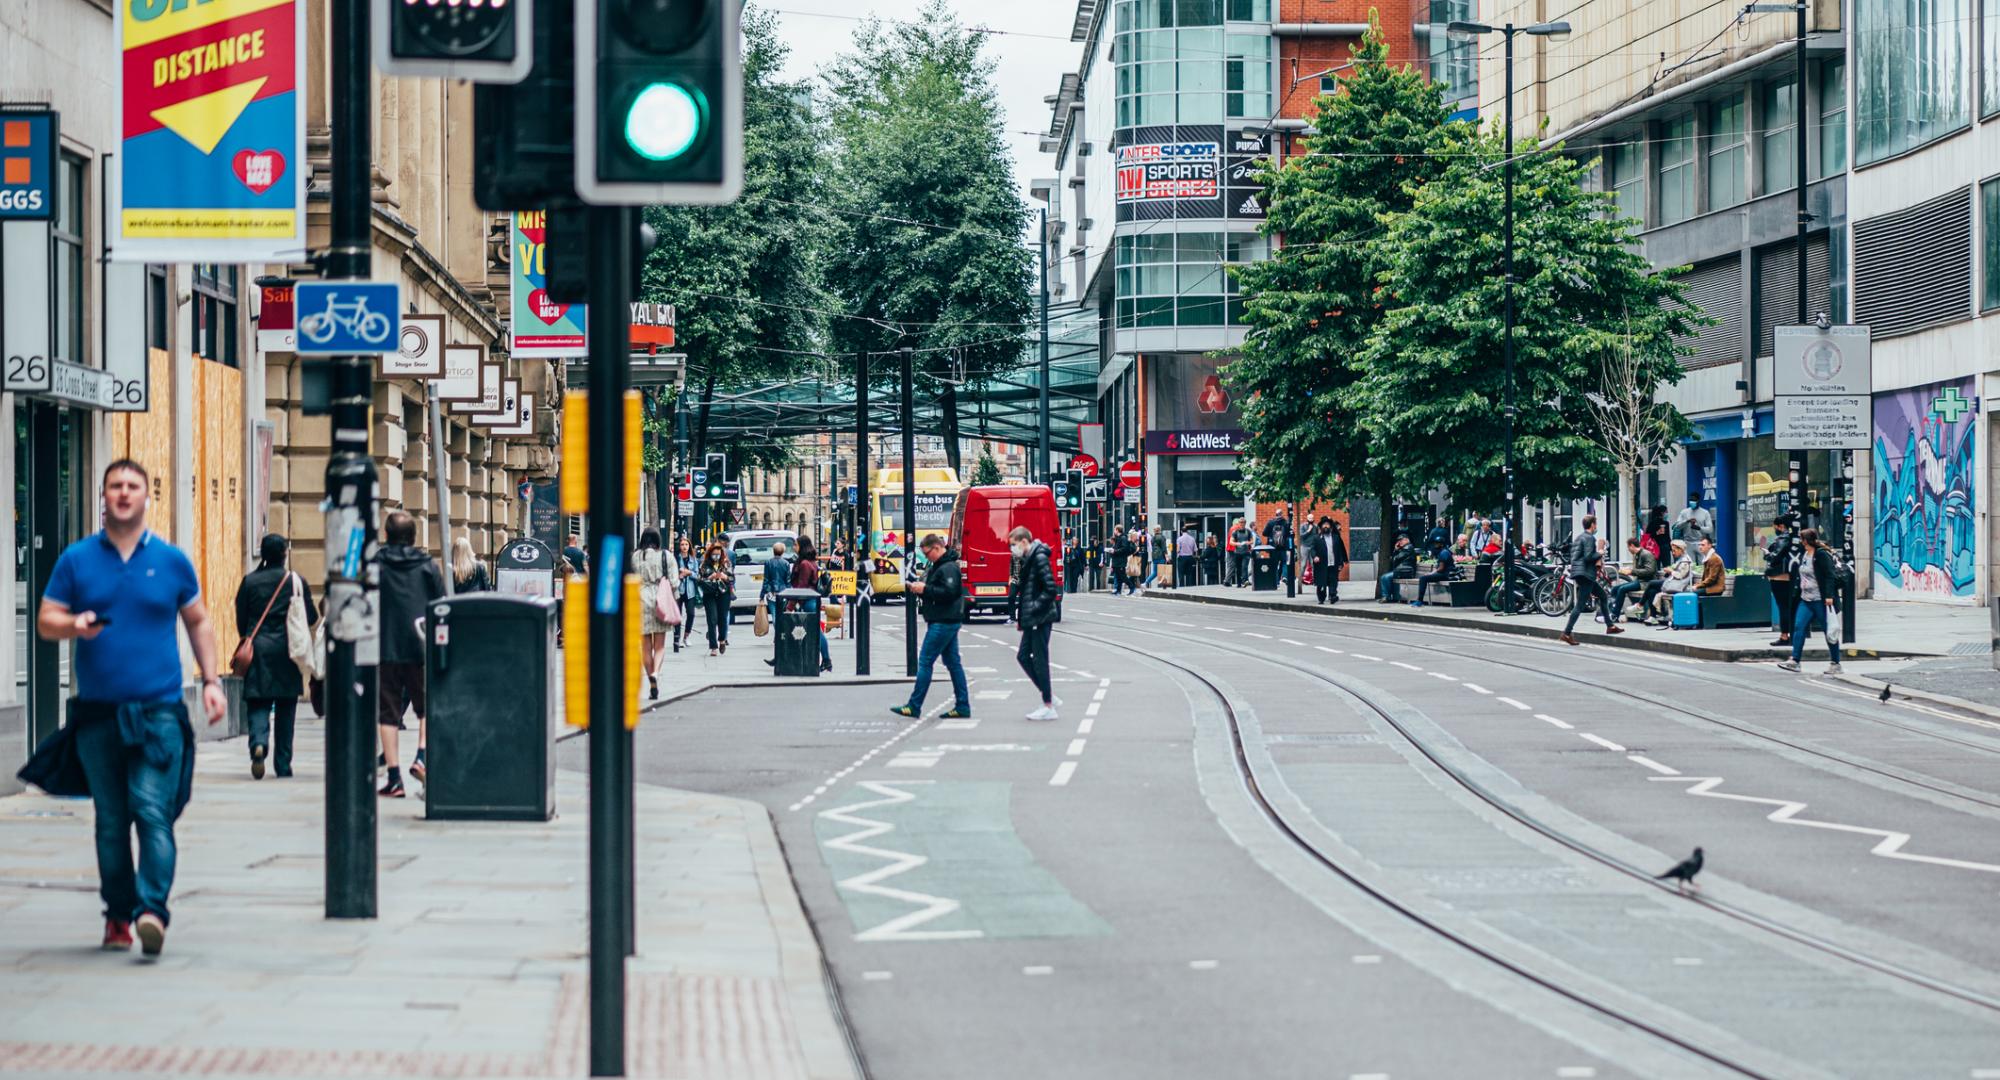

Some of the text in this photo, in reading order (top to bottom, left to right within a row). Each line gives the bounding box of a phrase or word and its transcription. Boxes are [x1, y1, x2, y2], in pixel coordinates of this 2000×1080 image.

[153, 29, 265, 88] DISTANCE
[1235, 141, 1261, 150] PUMA
[1148, 164, 1214, 179] SPORTS
[1149, 181, 1212, 197] STORES
[0, 189, 42, 210] GGS
[8, 355, 45, 382] 26
[113, 380, 142, 404] 26
[1180, 433, 1231, 449] NatWest
[914, 495, 953, 504] free bus
[914, 504, 943, 512] around
[930, 512, 945, 523] city
